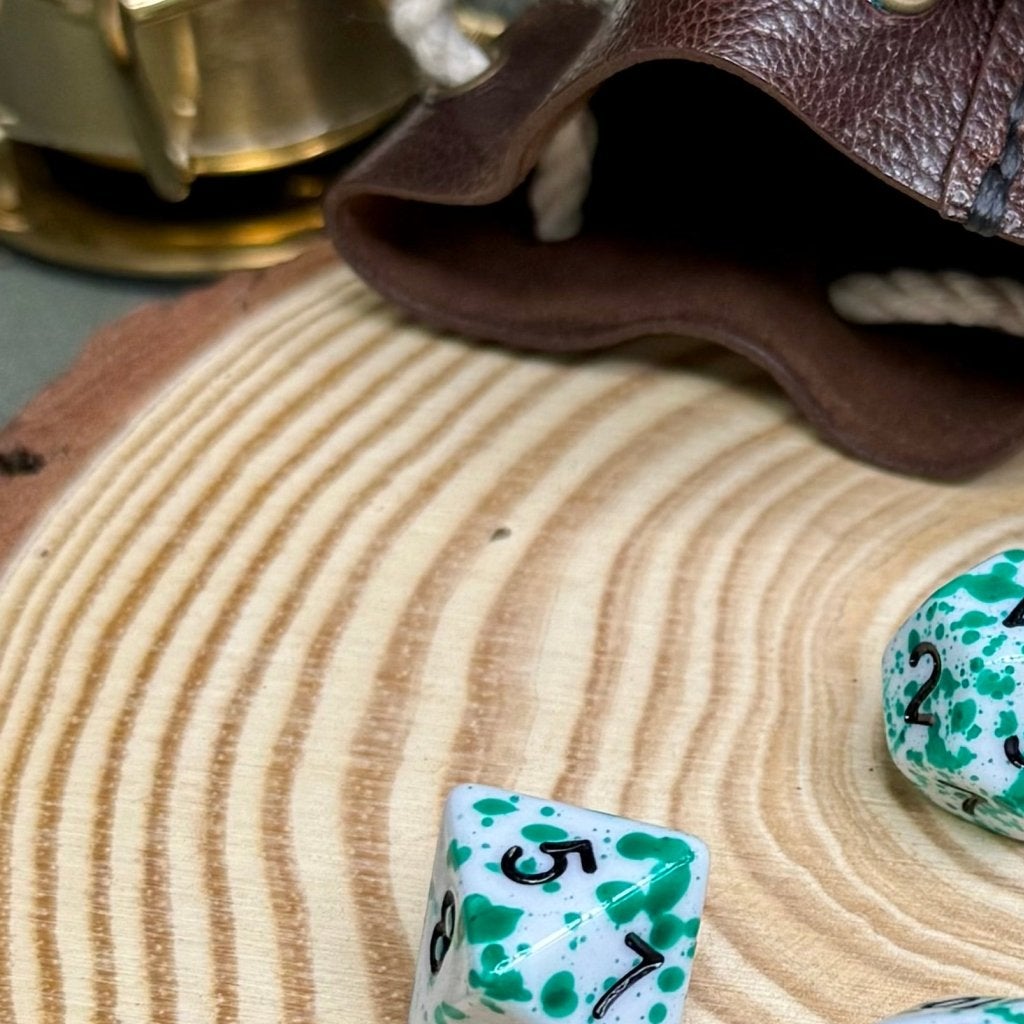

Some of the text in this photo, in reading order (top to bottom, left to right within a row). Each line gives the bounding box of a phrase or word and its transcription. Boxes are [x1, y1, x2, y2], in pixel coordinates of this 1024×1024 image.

[904, 642, 941, 726] 2
[501, 839, 597, 885] 5
[592, 932, 665, 1019] 7
